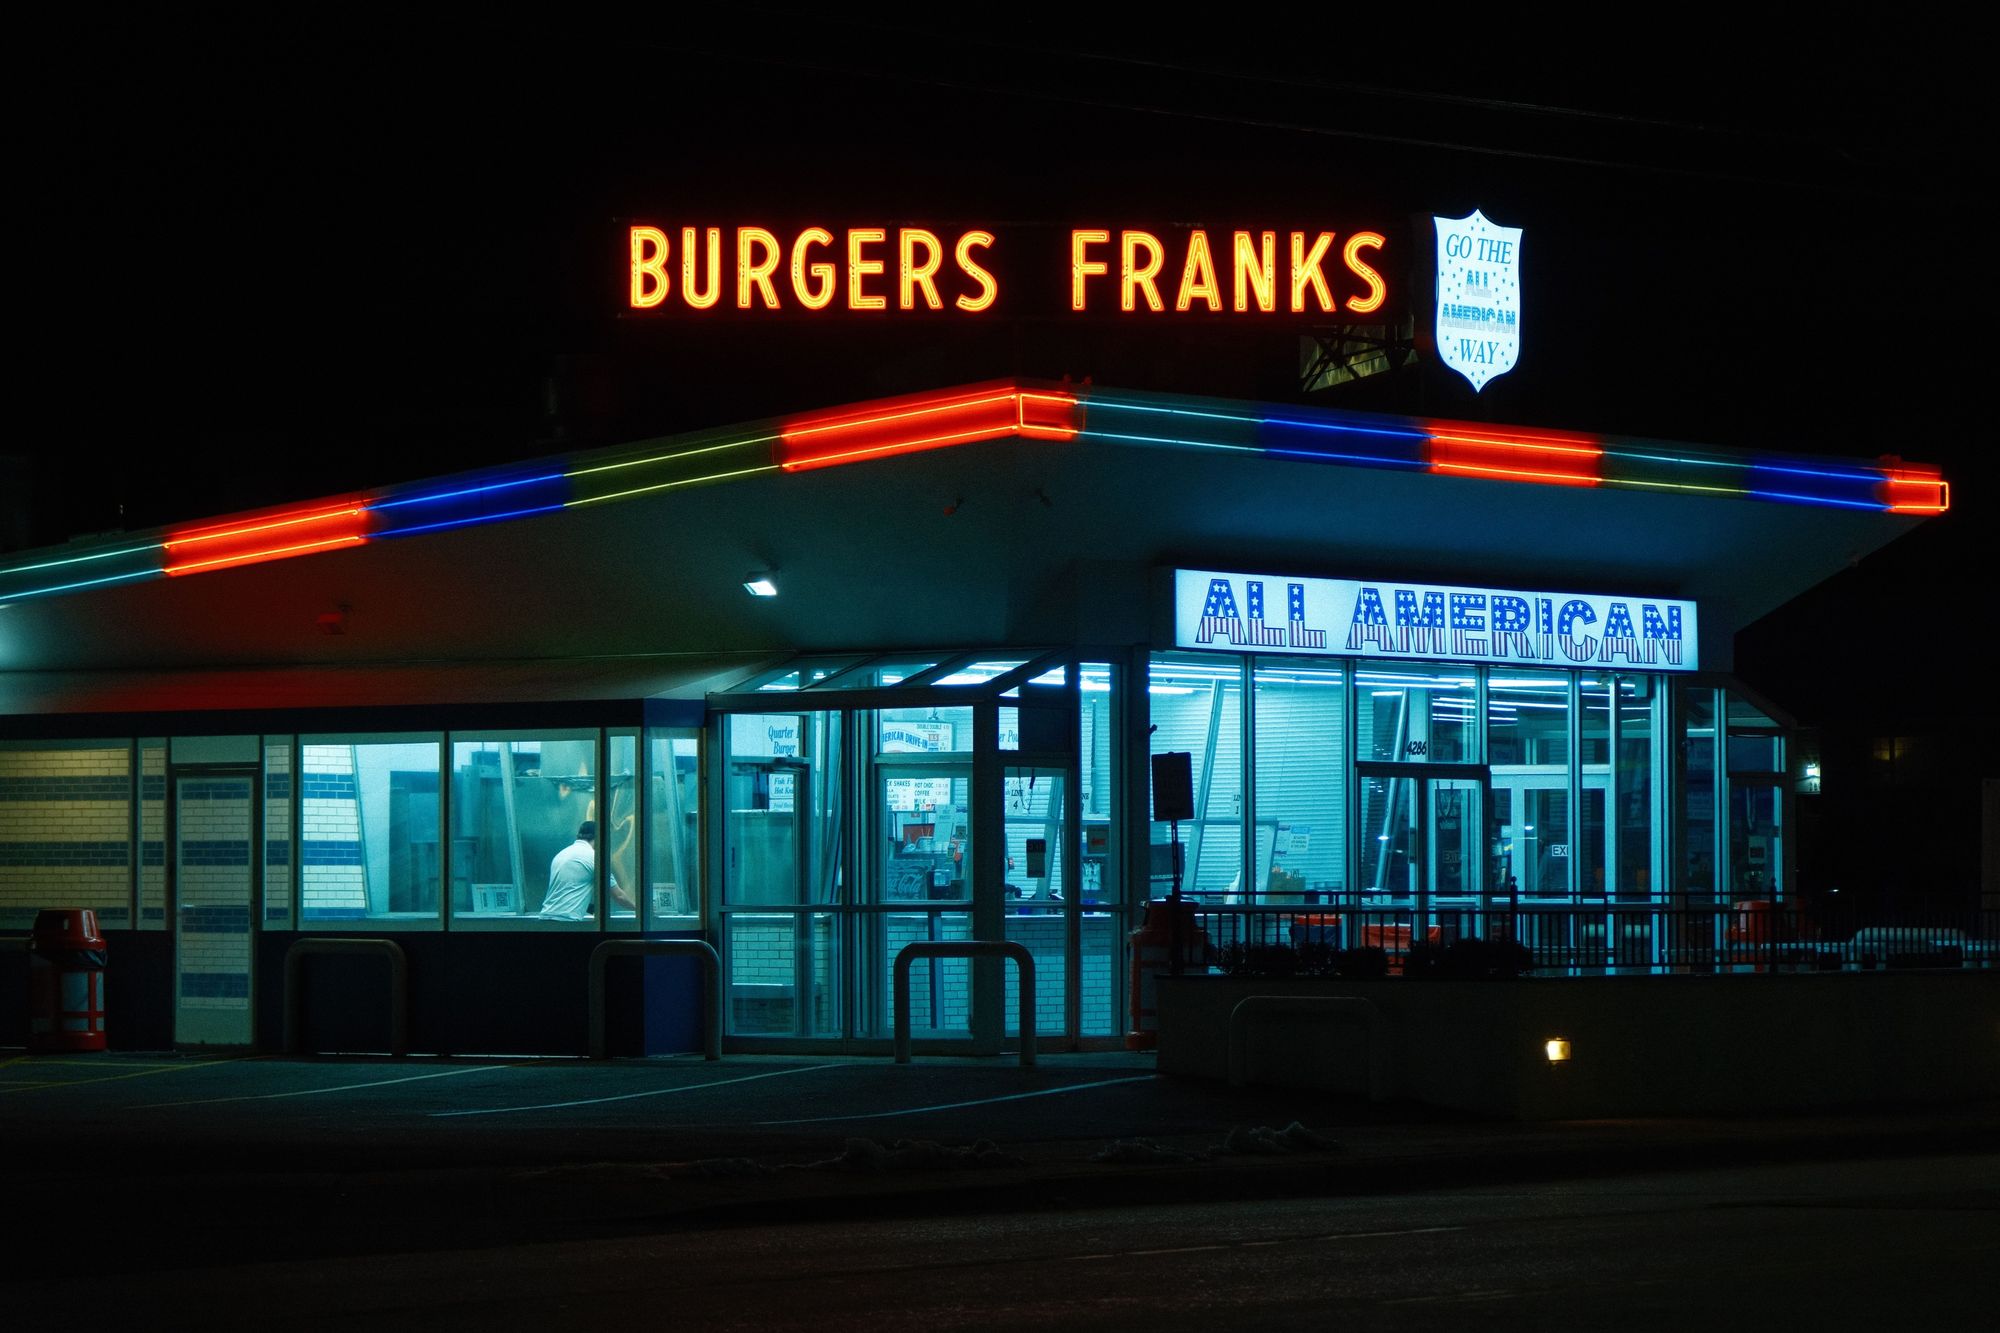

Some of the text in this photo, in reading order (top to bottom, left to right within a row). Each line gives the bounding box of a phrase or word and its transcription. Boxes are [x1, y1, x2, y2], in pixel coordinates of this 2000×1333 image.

[1446, 233, 1513, 264] GO THE
[629, 225, 1388, 314] BURGERS FRANKS
[1465, 269, 1492, 298] ALL
[1440, 303, 1516, 335] AMERICAN
[1460, 338, 1500, 365] WAY
[1195, 579, 1684, 666] ALL AMERICAN
[768, 725, 794, 742] Quarter
[773, 741, 796, 756] Burger
[1407, 741, 1427, 755] 4286
[1013, 800, 1018, 810] 4
